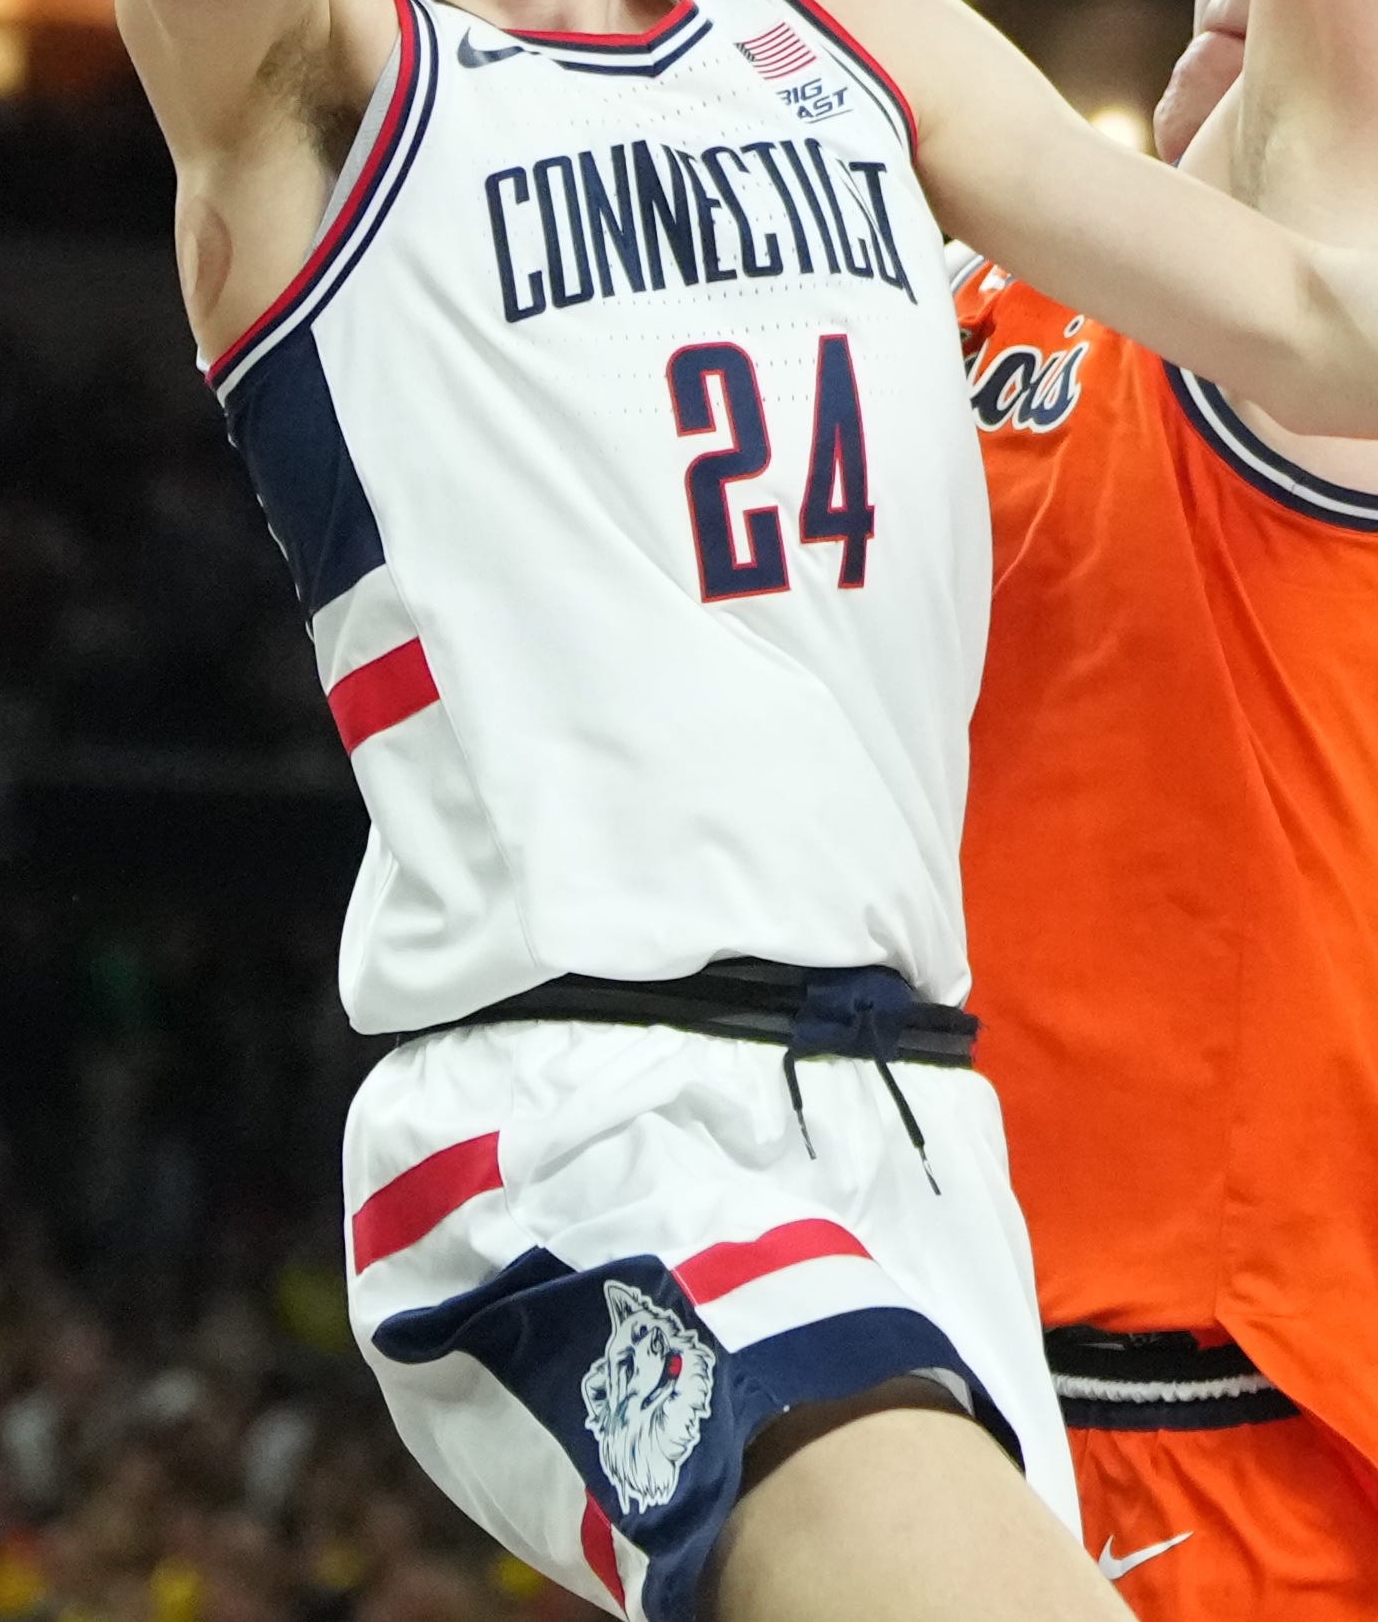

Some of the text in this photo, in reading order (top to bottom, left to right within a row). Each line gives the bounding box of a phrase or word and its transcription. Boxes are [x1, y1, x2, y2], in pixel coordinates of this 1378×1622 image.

[796, 86, 849, 119] AST
[965, 314, 1090, 434] ois
[665, 333, 875, 604] 24
